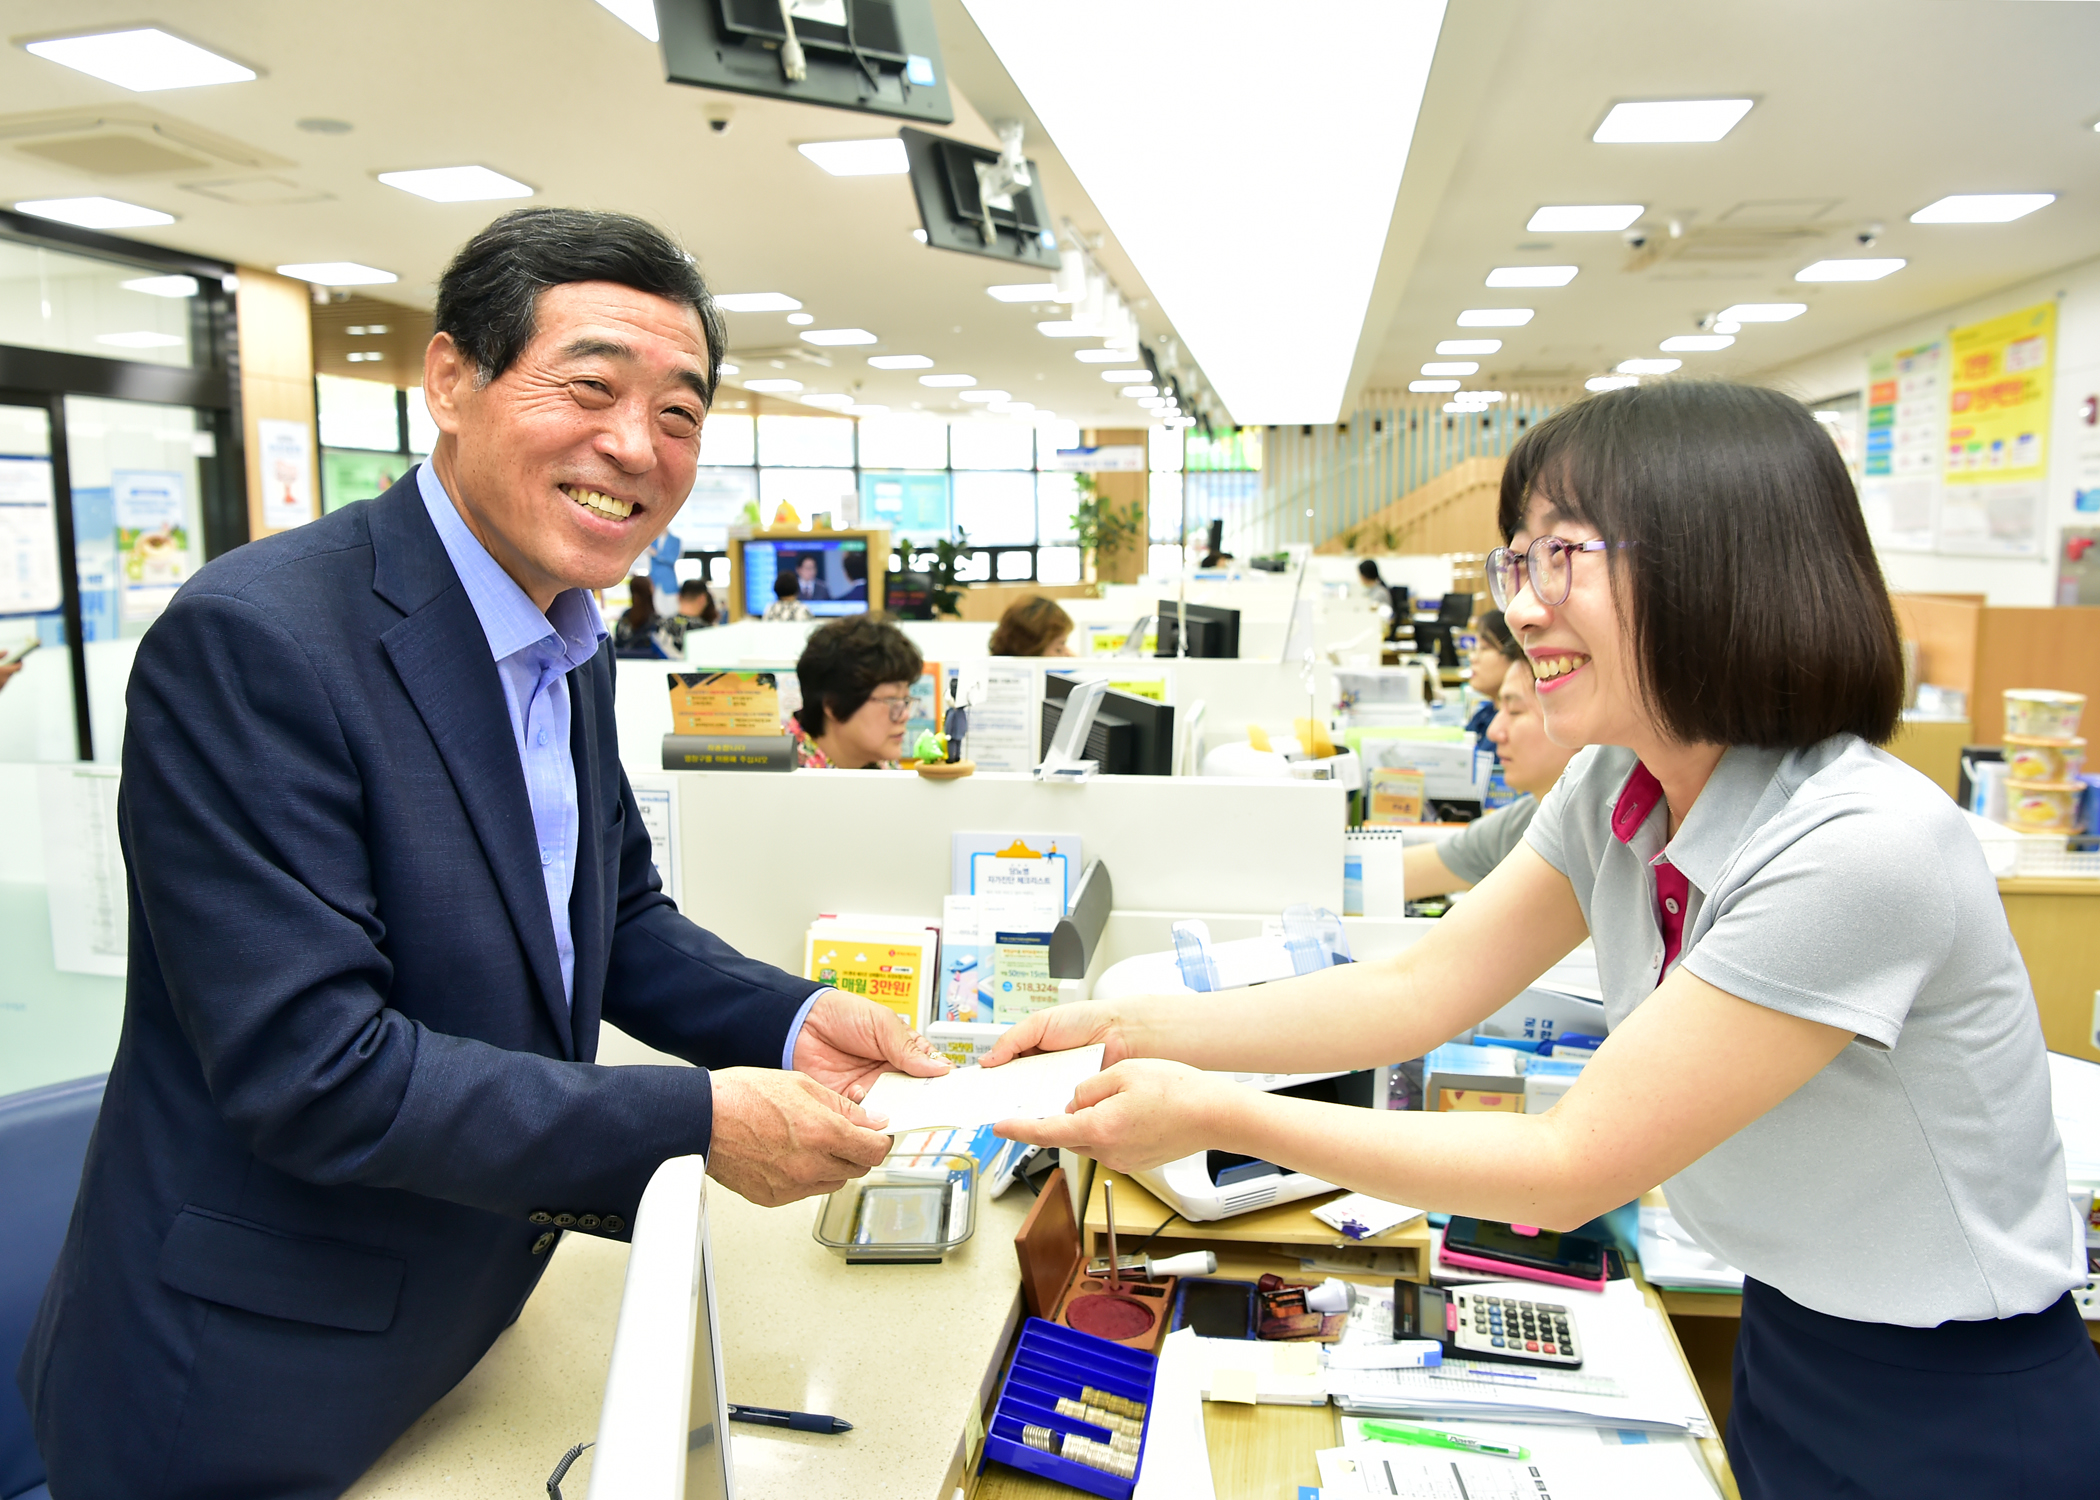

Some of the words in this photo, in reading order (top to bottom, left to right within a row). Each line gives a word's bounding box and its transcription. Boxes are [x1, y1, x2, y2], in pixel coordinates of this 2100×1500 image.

[988, 876, 1016, 885] 자가진단
[1017, 876, 1051, 885] 체크리스트
[842, 977, 867, 994] 매월
[869, 979, 911, 997] 3만원!
[1449, 1435, 1478, 1445] Power
